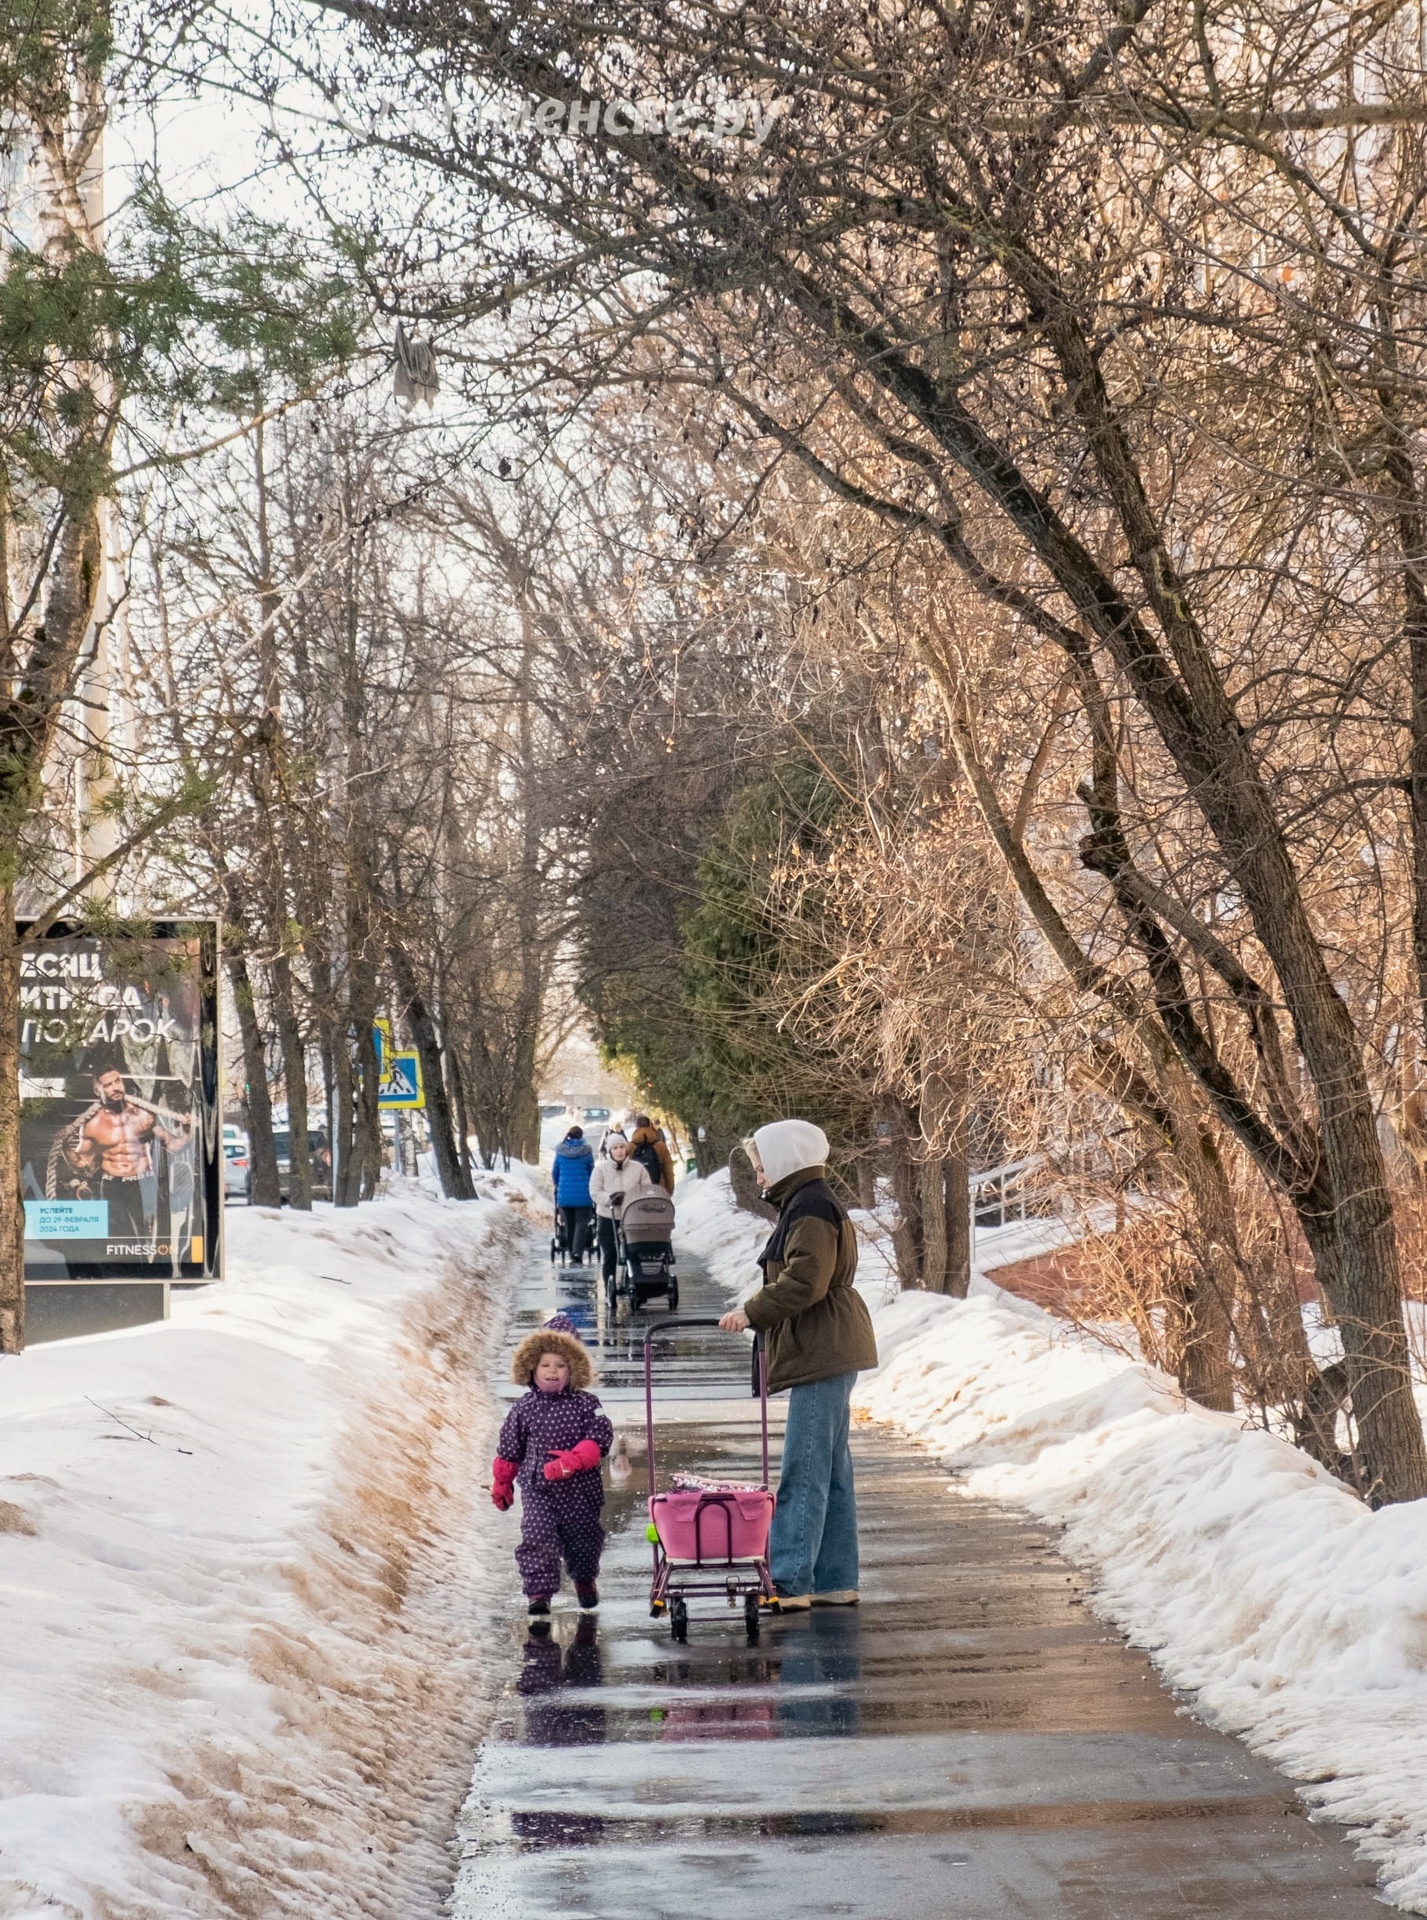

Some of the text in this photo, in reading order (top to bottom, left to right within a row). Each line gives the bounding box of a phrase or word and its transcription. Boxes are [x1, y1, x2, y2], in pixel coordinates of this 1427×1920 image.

[20, 952, 103, 981] ЕСЯЦ
[40, 1206, 73, 1214] УСПЕЙТЕ
[39, 1216, 52, 1224] ДО
